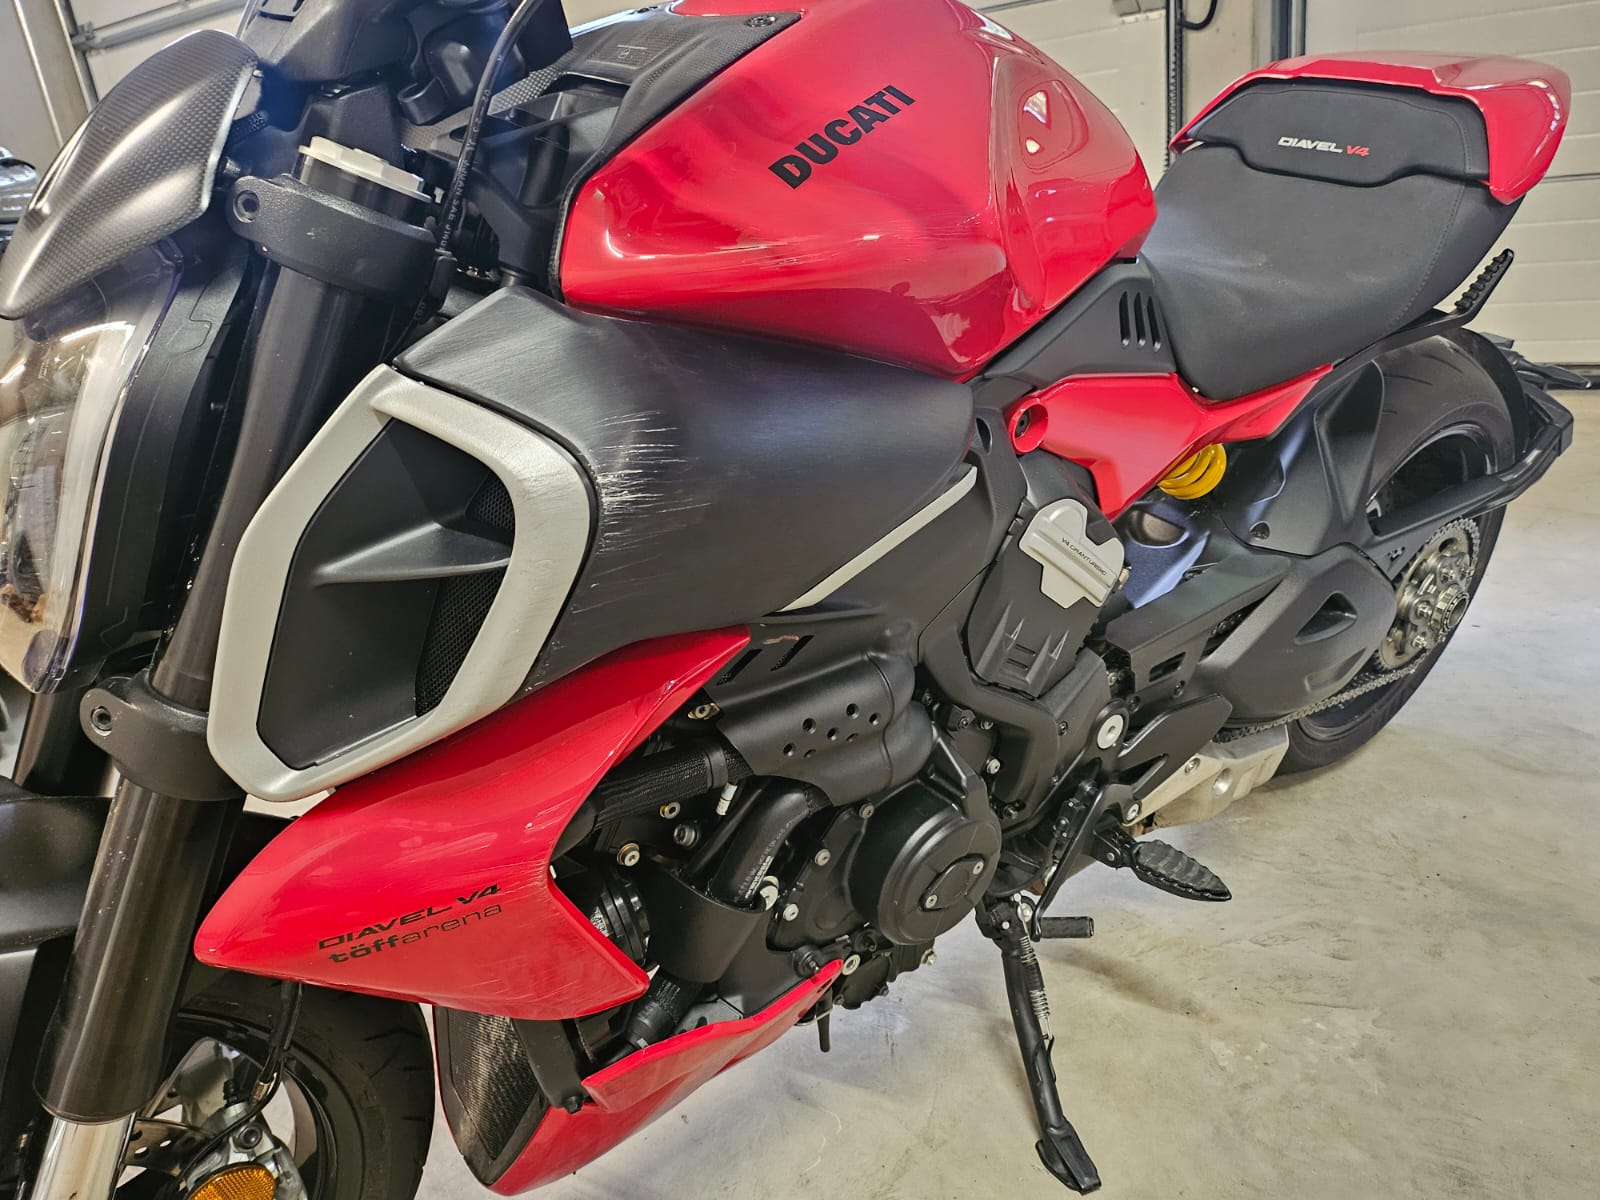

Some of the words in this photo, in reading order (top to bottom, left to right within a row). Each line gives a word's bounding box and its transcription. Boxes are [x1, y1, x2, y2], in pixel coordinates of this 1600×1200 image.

[768, 85, 915, 189] DUCATI
[1278, 136, 1343, 153] DIAVEL
[1346, 144, 1370, 157] V4
[318, 906, 453, 950] DIAVEL
[456, 884, 501, 904] V4
[329, 903, 502, 963] töffarena
